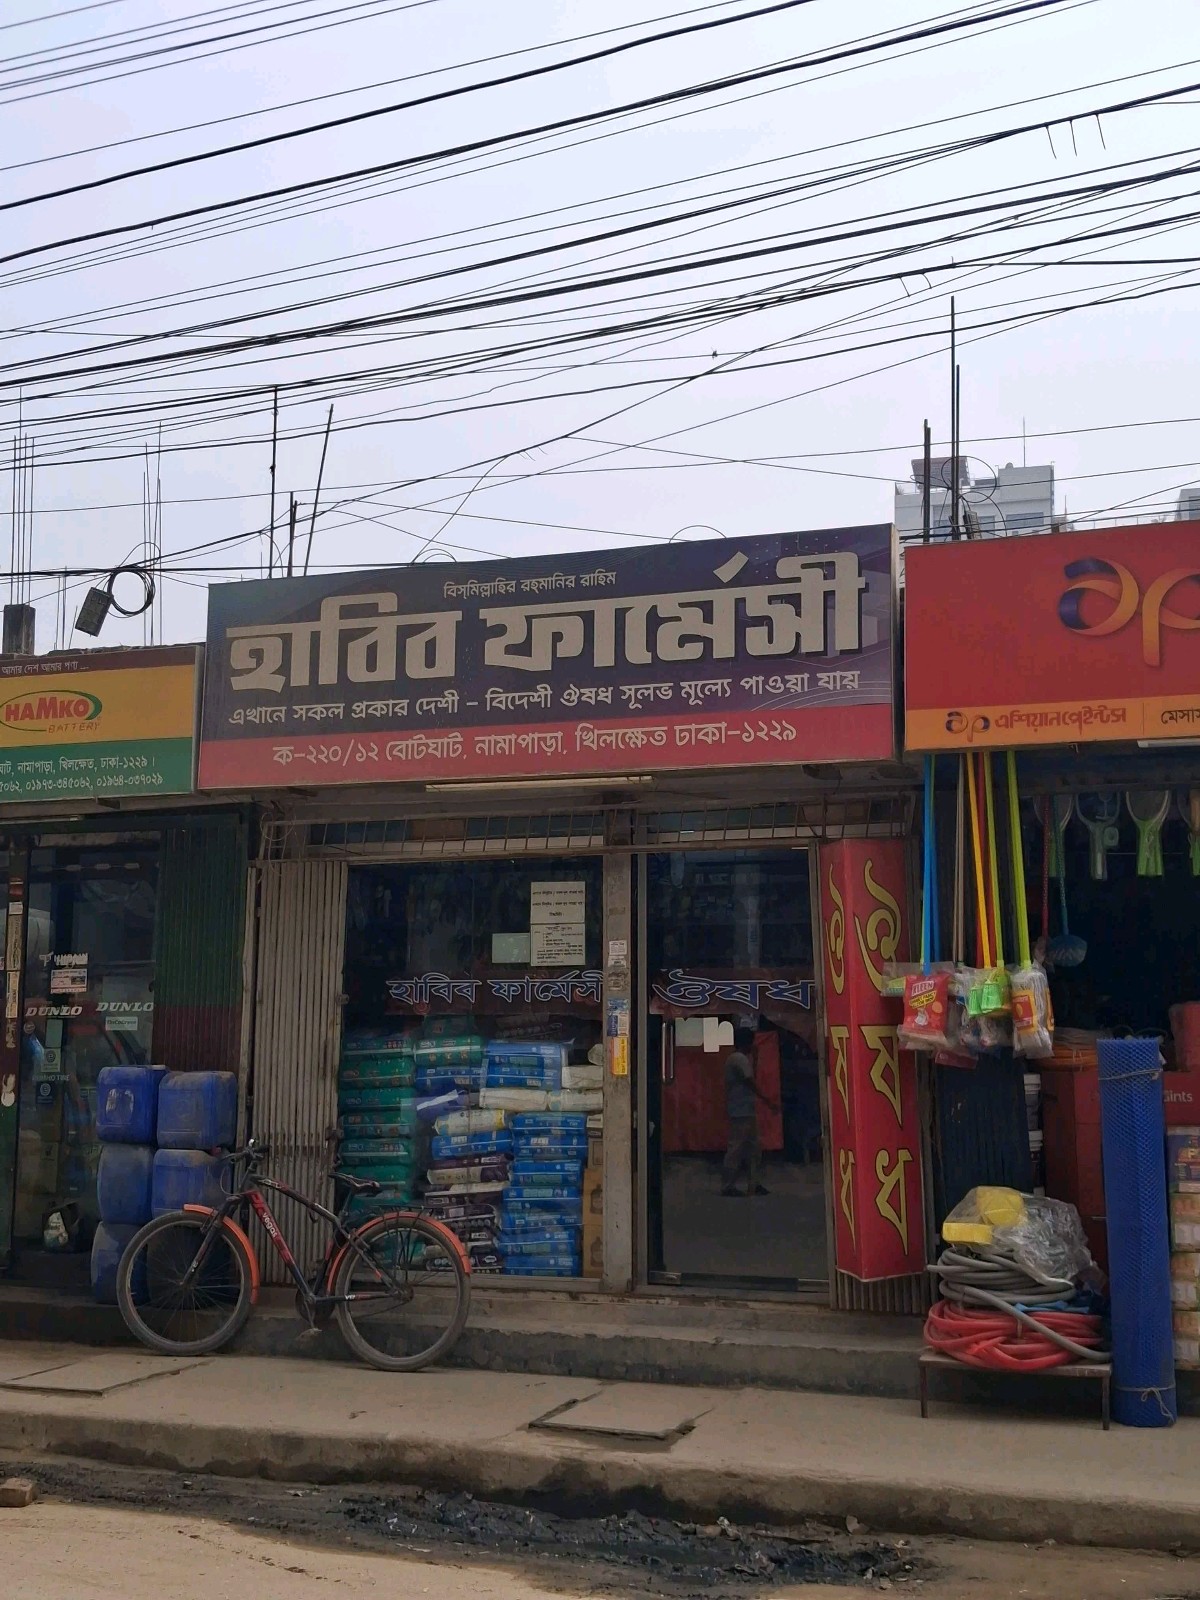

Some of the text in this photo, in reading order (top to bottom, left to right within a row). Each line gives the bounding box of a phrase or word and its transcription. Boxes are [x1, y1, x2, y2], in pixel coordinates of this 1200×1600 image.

[580, 568, 617, 588] রাহিম
[226, 550, 866, 694] হাবিব ফার্মেসী
[5, 696, 90, 722] HAMKO
[228, 705, 288, 726] এখানে
[292, 702, 346, 722] সকল
[351, 698, 410, 719] প্রকার
[415, 688, 460, 716] দেশী
[485, 683, 553, 712] বিদেশী
[680, 678, 733, 706] মূল্যে
[740, 673, 810, 696] পাওয়া
[816, 670, 861, 691] যায়
[48, 721, 99, 734] BATTERY
[272, 739, 380, 767] ক-২২০/১২
[575, 722, 668, 753] খিলক্ষেত
[673, 720, 798, 747] ঢাকা-১২২৯
[386, 973, 483, 1005] হাবিব
